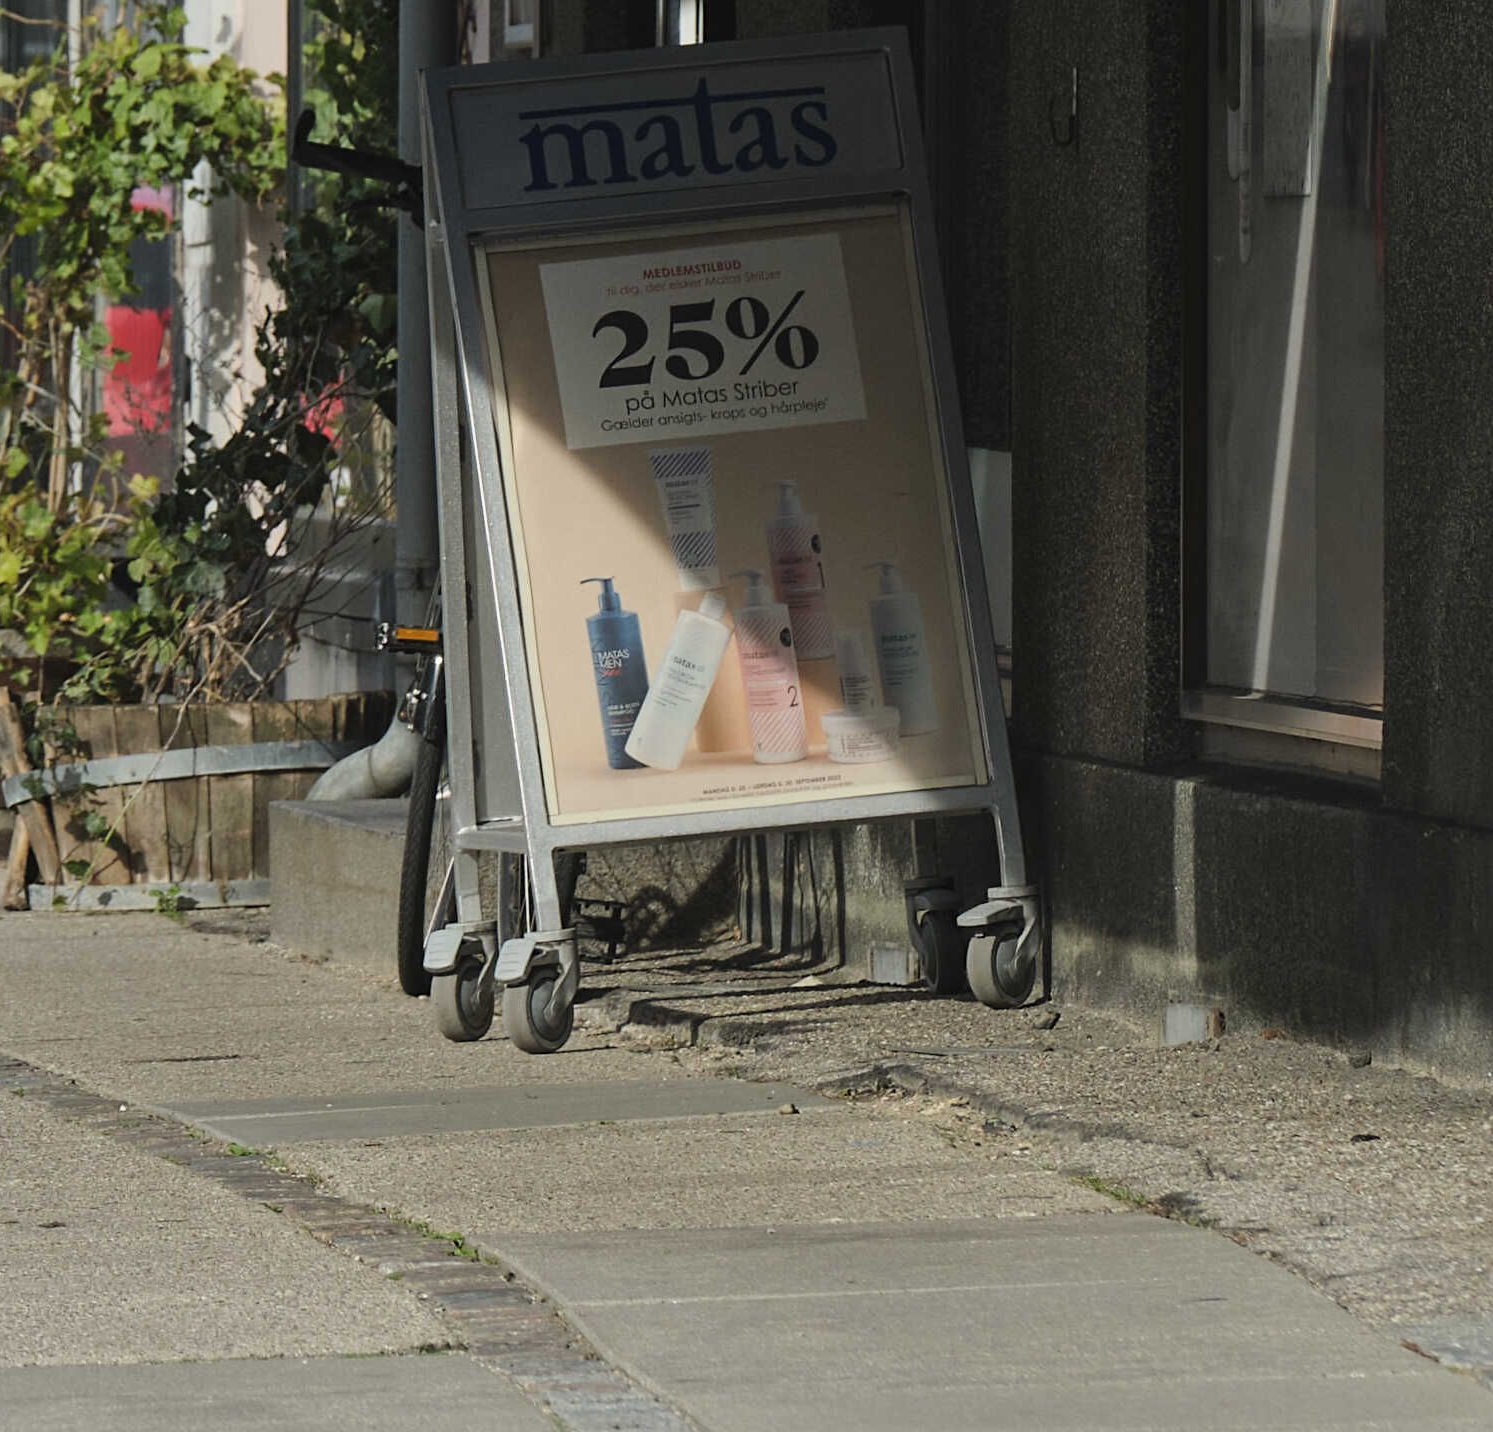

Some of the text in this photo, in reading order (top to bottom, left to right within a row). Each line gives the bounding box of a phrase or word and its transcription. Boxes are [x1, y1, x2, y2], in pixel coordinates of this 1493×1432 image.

[518, 76, 838, 192] matas
[642, 258, 743, 281] MEDLEMSTILBUD
[591, 288, 820, 389] 25%
[624, 379, 799, 415] på Matas Striber
[601, 414, 654, 432] Gælder
[710, 407, 746, 424] krops
[748, 406, 768, 420] og
[787, 685, 799, 707] 2
